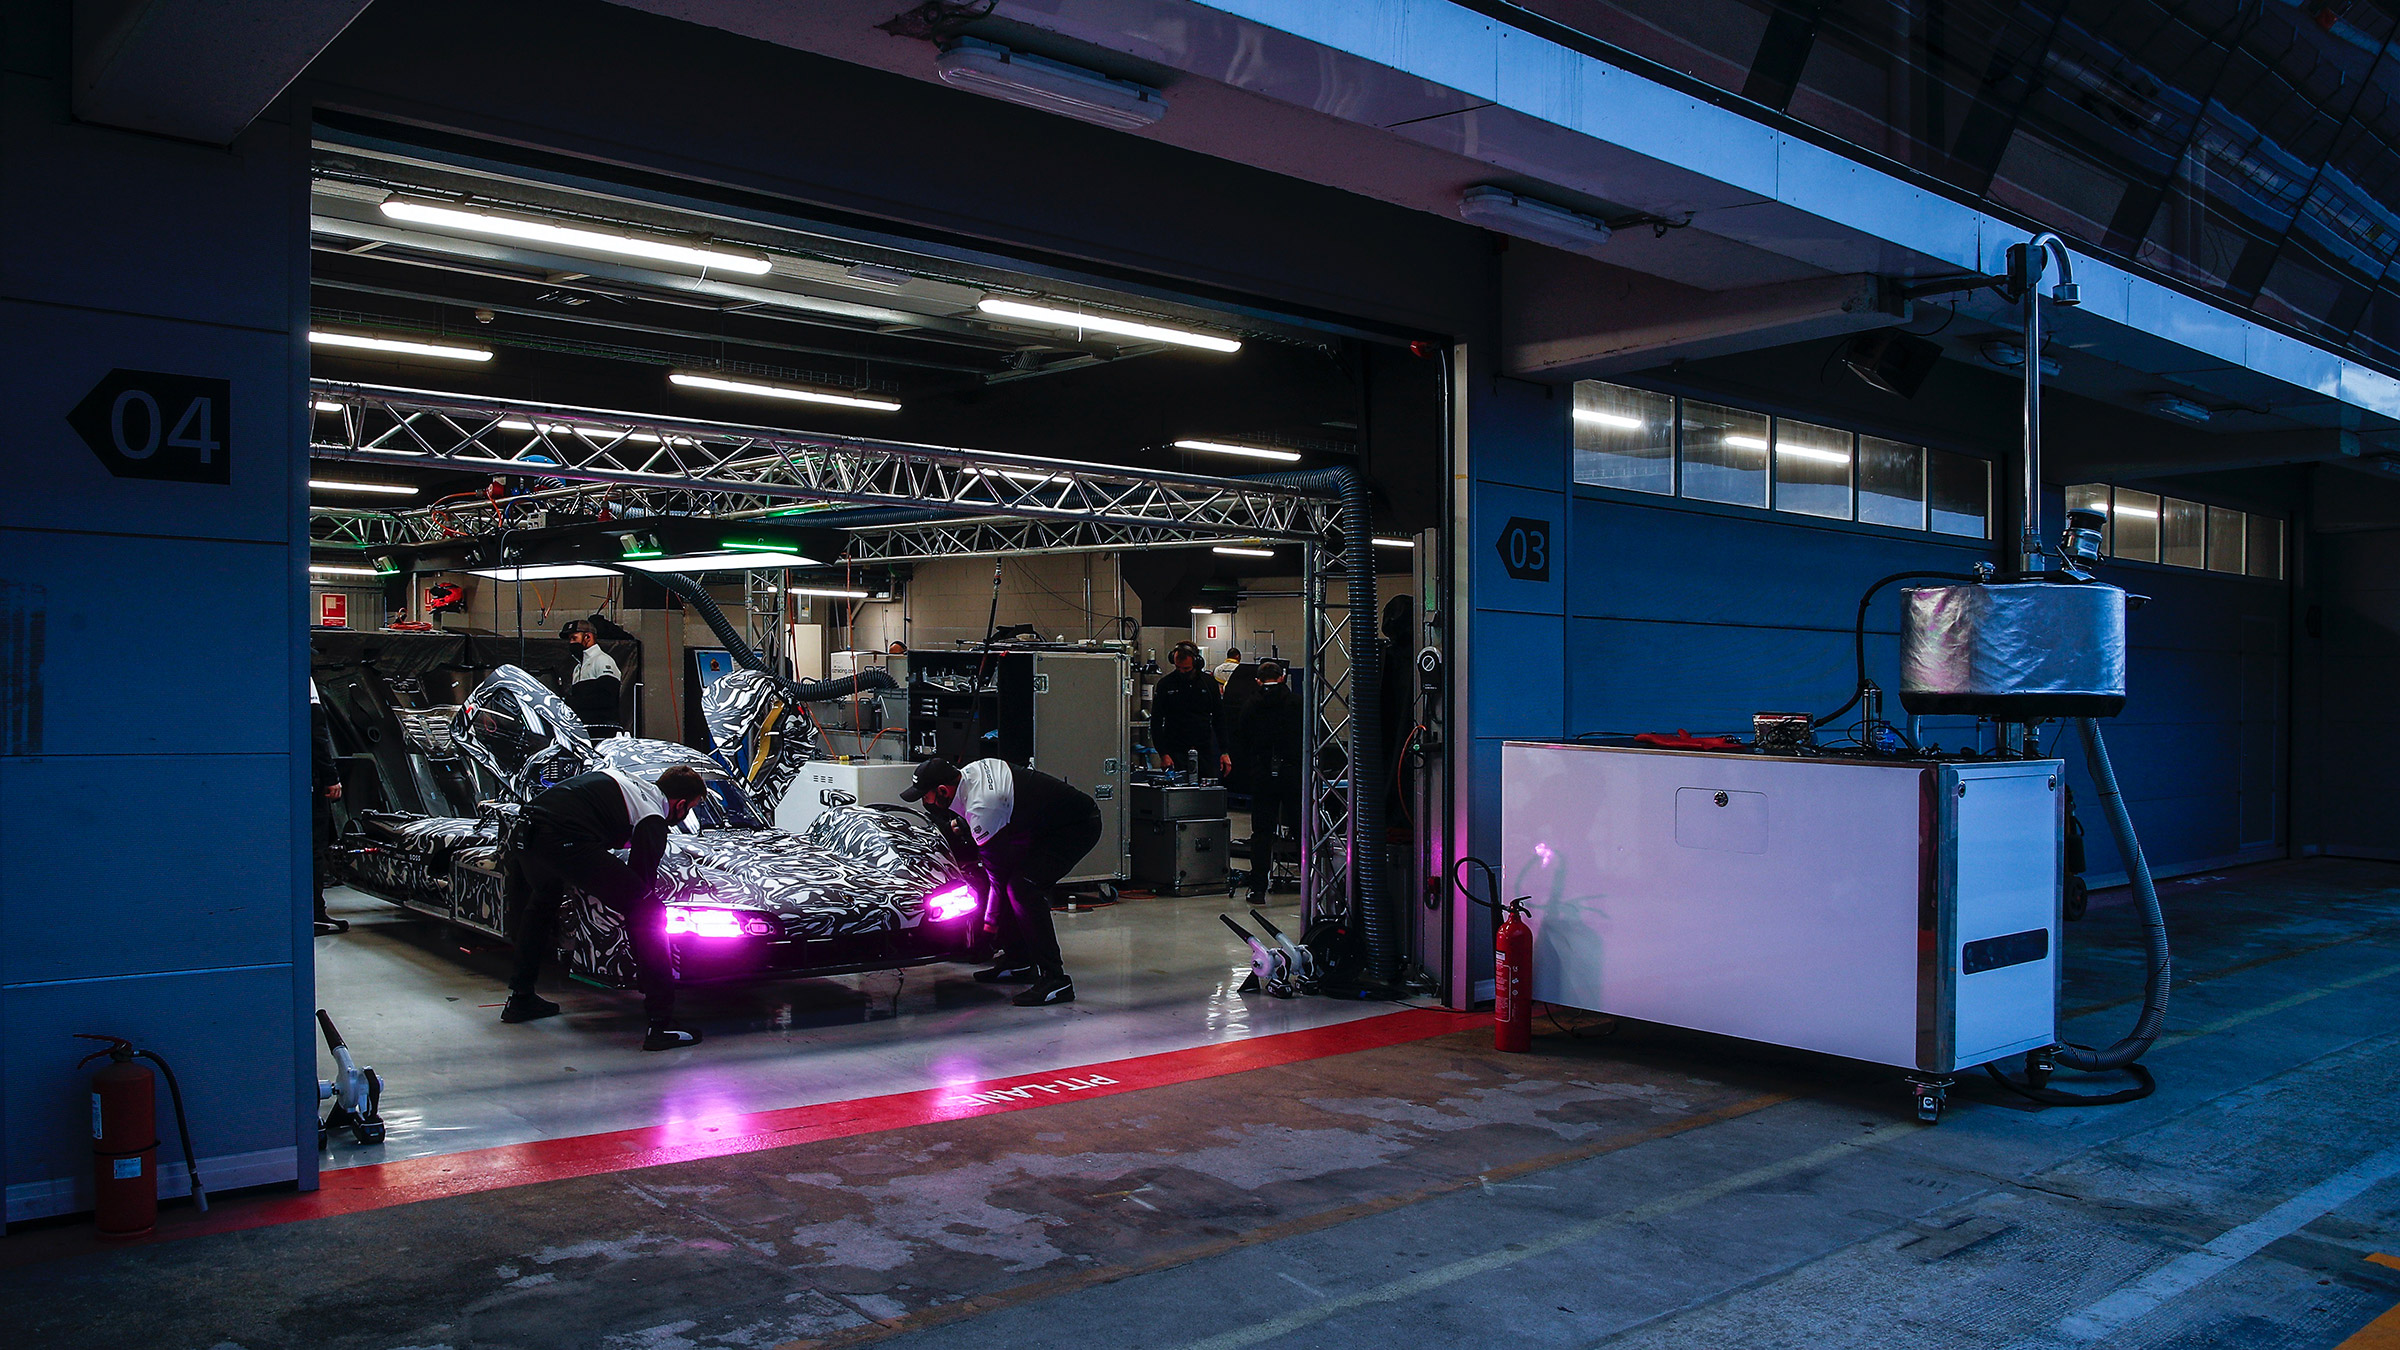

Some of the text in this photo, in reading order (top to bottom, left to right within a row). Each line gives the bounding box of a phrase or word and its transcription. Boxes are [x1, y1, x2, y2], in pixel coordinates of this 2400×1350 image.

[110, 389, 221, 464] 04
[1510, 528, 1545, 570] 03
[949, 1074, 1120, 1107] PIT-LANE
